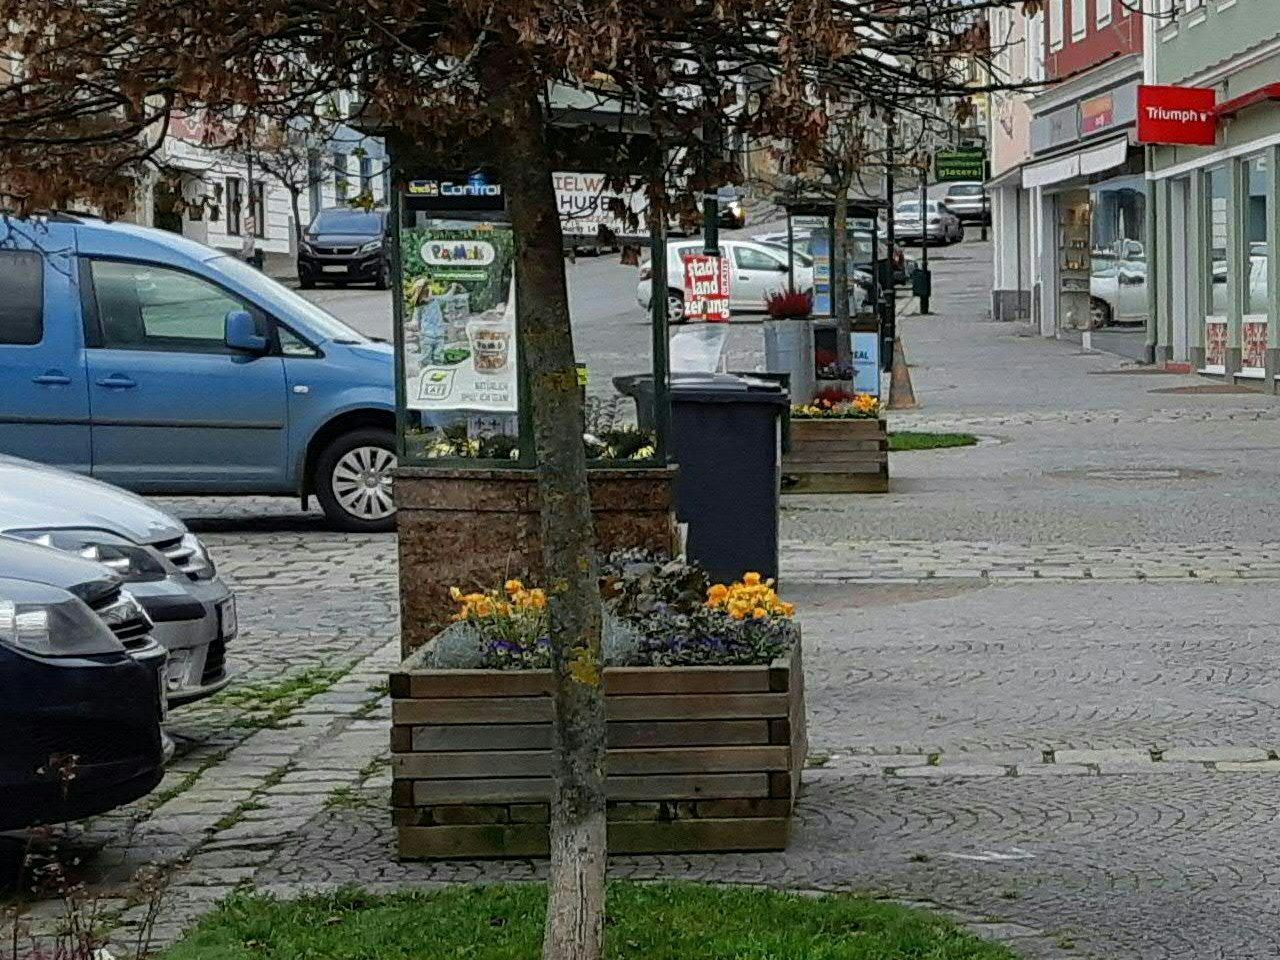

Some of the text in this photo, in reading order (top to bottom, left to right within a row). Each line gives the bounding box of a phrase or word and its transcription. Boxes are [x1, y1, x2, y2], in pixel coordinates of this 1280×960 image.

[1146, 106, 1198, 123] Triumph
[687, 257, 719, 277] stadt
[691, 276, 718, 295] land
